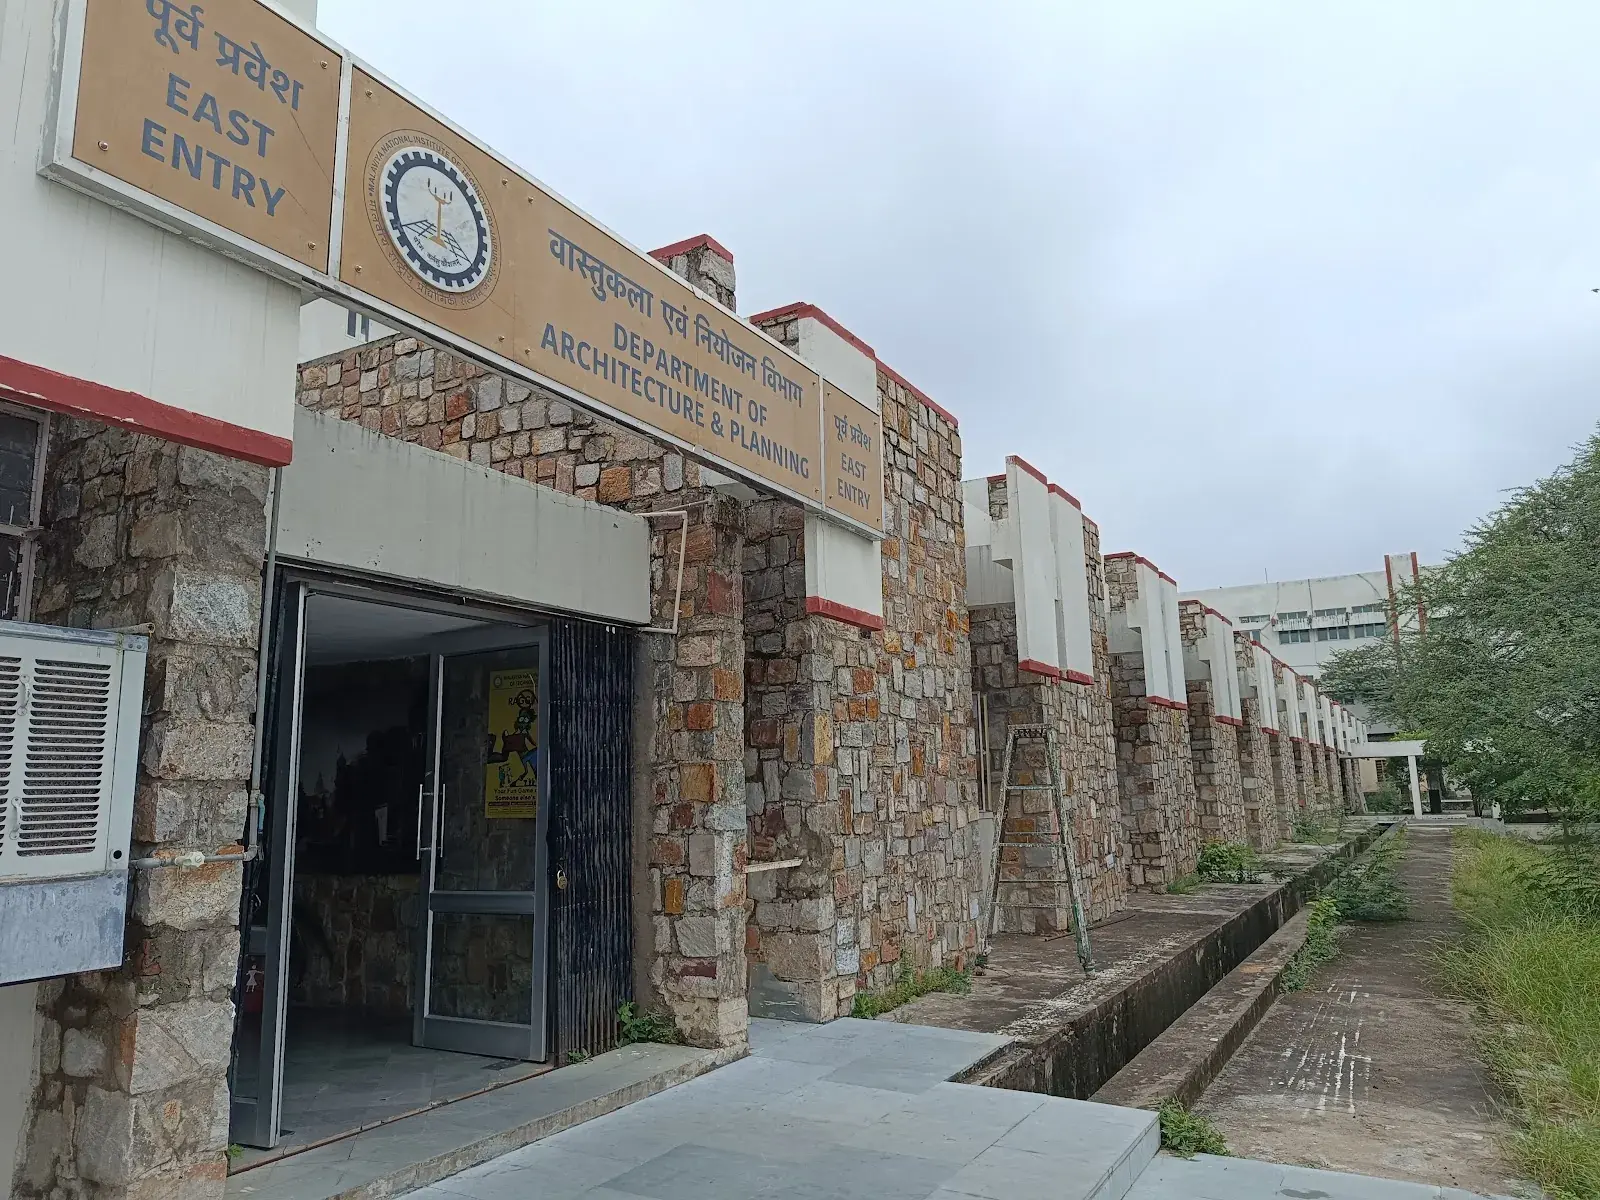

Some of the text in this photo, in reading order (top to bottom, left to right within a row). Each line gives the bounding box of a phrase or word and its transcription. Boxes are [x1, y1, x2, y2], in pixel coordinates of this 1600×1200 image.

[146, 0, 304, 111] पूर्व प्रवेश
[166, 72, 275, 158] EAST
[141, 117, 286, 217] ENTRY
[381, 135, 414, 153] NATIONAL
[413, 136, 450, 160] INSTITUTE
[451, 154, 462, 169] OF
[461, 166, 495, 230] TECHNOLOGY
[548, 228, 803, 408] वास्तुकला एवं नियोजन विभाग
[540, 322, 809, 479] ARCHITECTURE & PLANNING
[613, 322, 767, 427] DEPARTMENT OF
[833, 414, 872, 453] पूर्व प्रवेश
[841, 452, 867, 482] EAST
[837, 477, 871, 510] ENTRY
